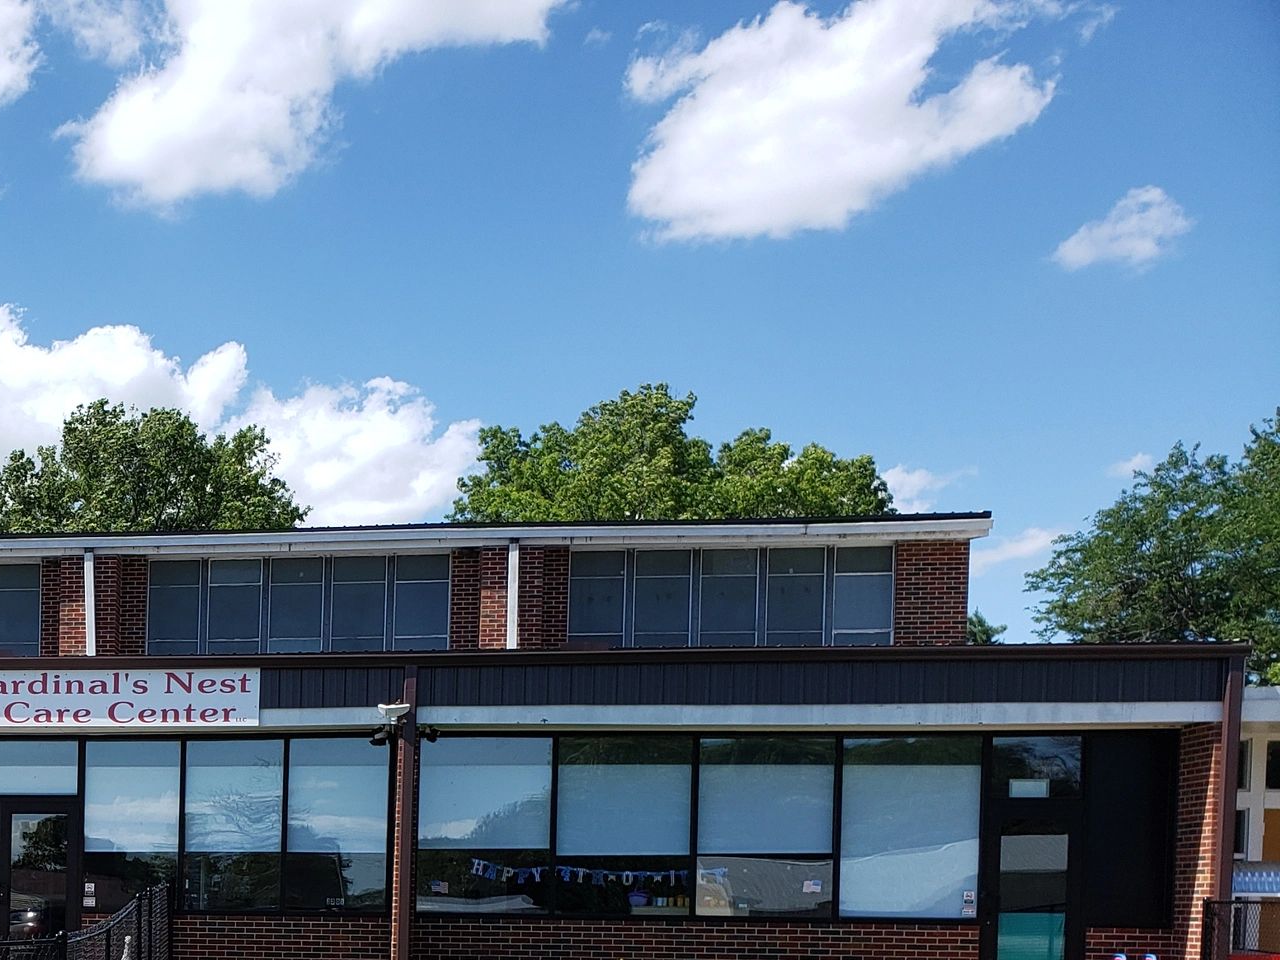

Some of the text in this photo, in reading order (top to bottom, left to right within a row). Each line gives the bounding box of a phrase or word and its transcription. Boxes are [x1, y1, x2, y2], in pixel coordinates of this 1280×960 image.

[164, 672, 252, 694] Nest
[3, 701, 92, 724] Care
[107, 701, 237, 724] Center
[470, 857, 541, 884] HAPPY
